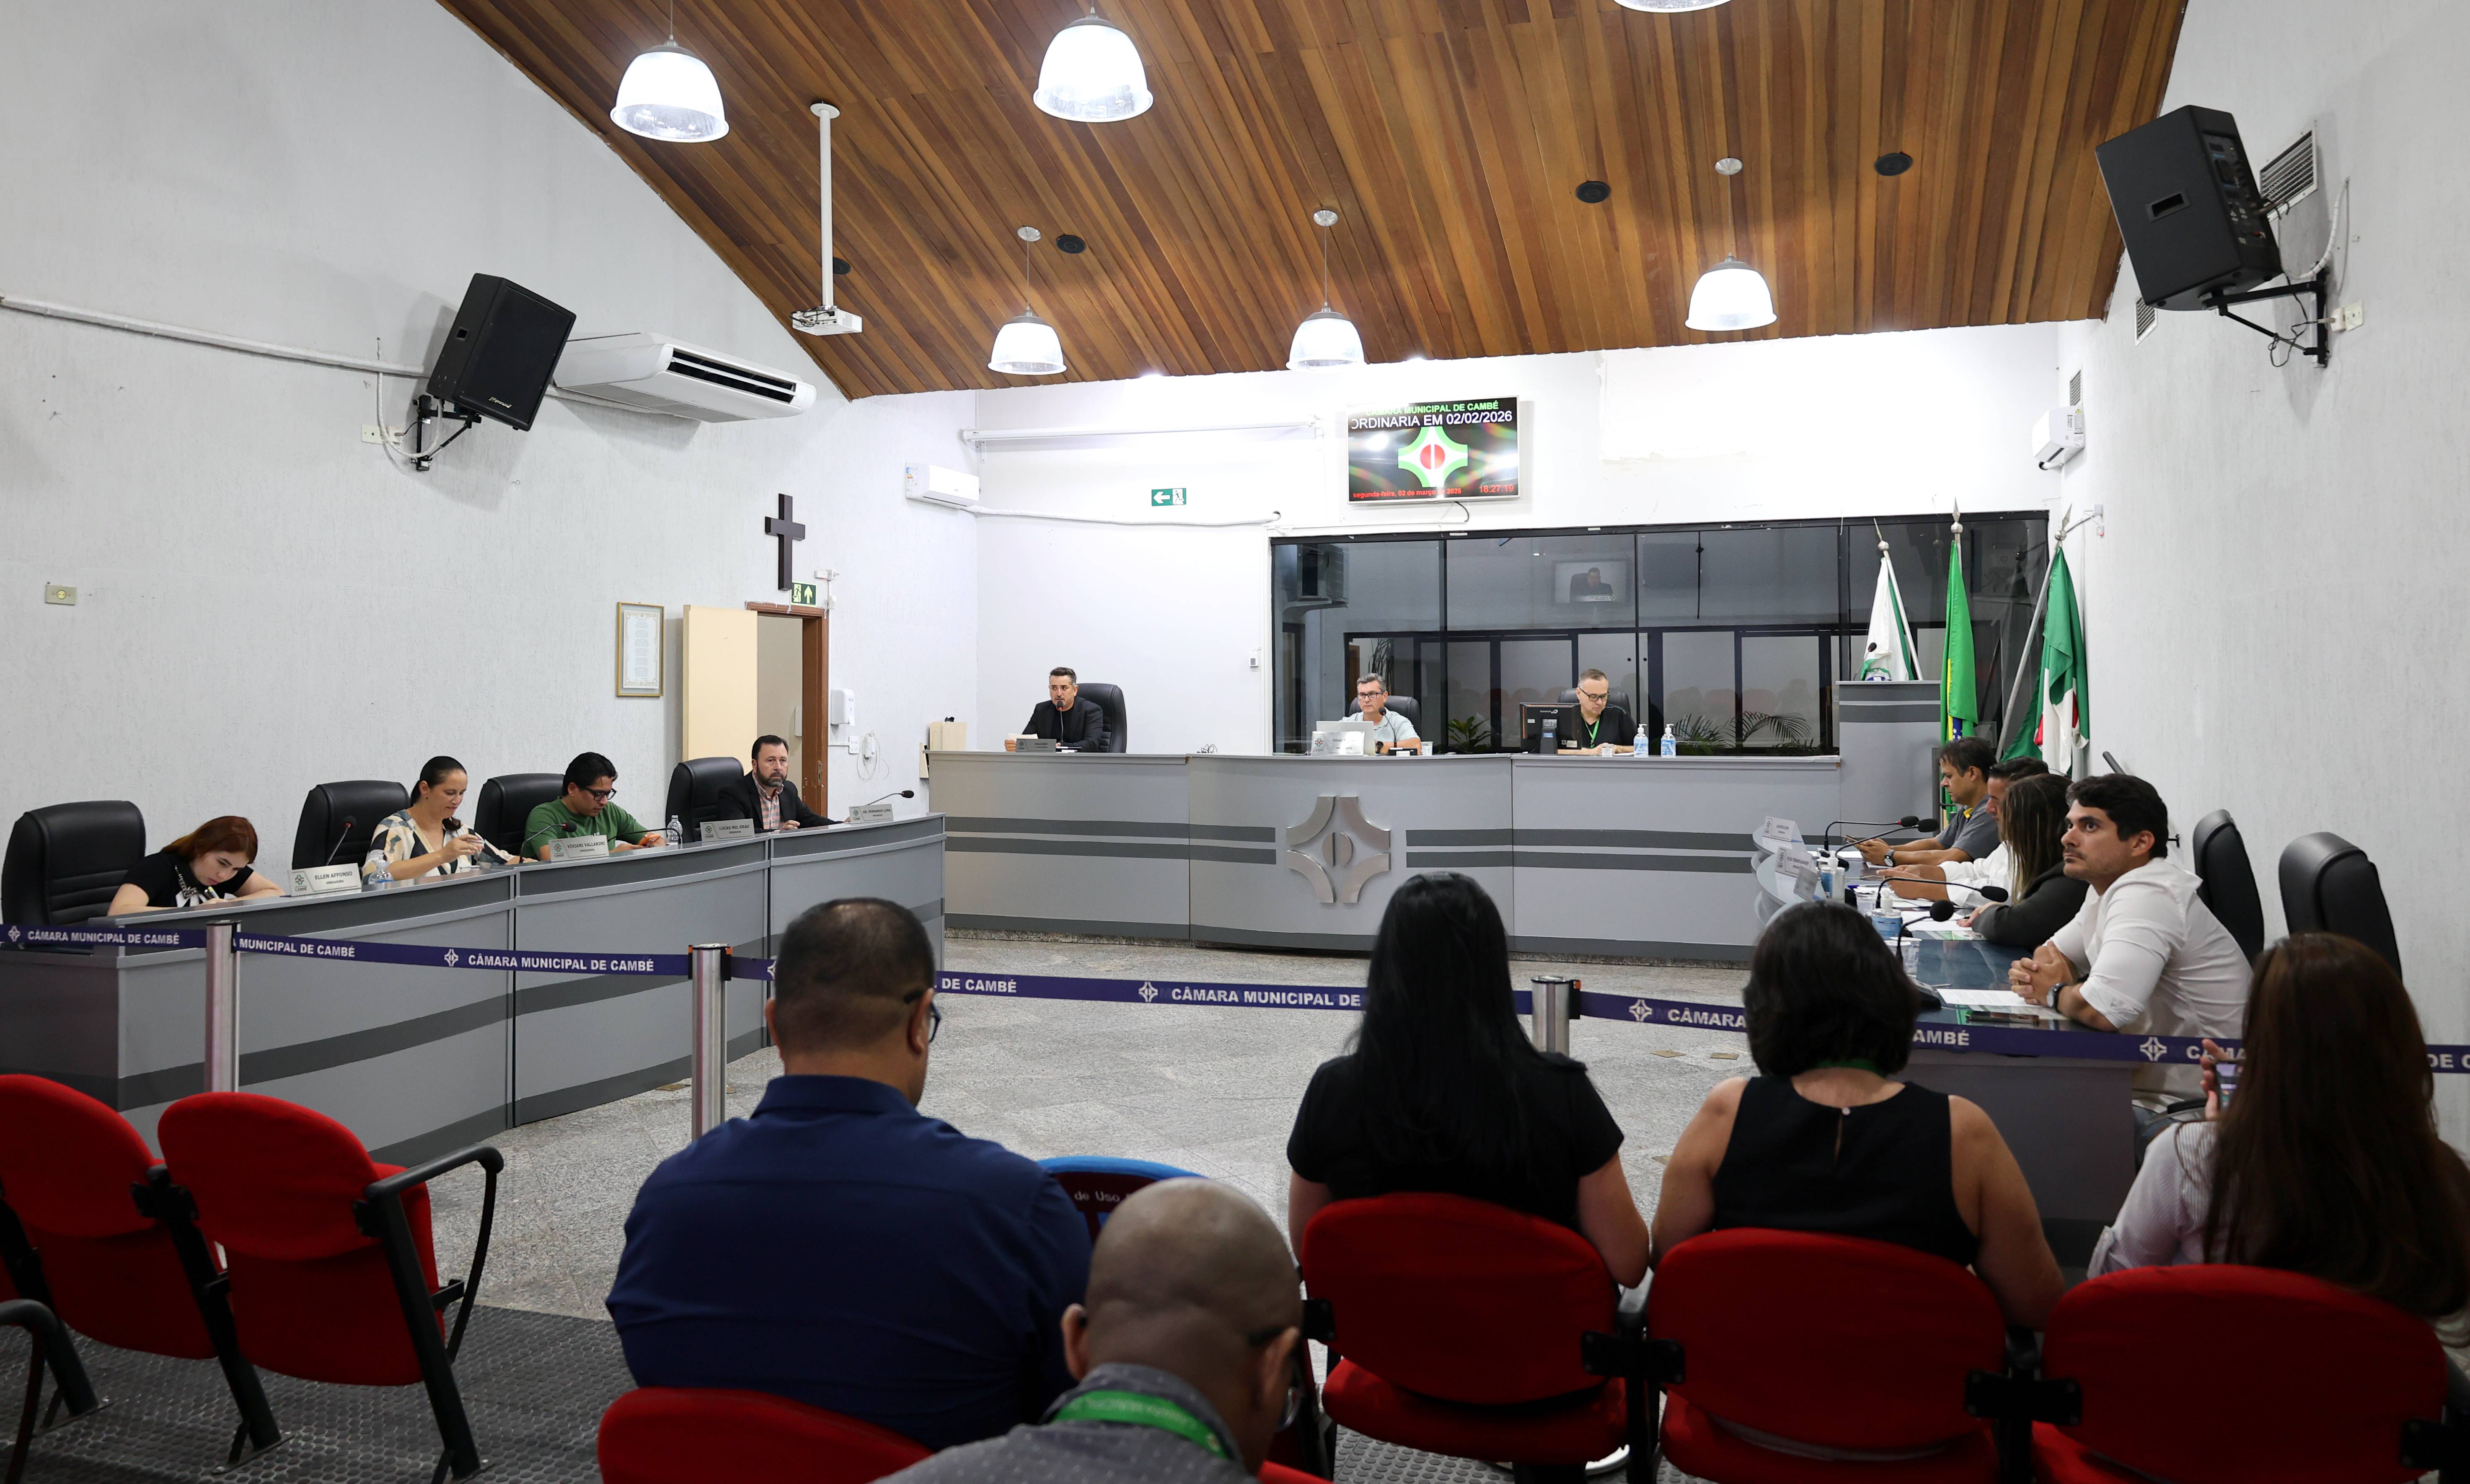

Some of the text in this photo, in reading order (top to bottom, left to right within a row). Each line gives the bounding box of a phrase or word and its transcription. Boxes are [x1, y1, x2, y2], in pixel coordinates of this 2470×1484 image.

[1404, 405, 1451, 414] MUNICIPAL
[1467, 400, 1499, 411] CAMBÉ
[1423, 414, 1443, 426] EM
[1446, 410, 1513, 425] 02/02/2026
[1478, 484, 1514, 493] 18:27:19
[28, 929, 180, 944] CÂMARA MUNICIPAL DE CAMBÉ
[239, 938, 297, 952] MUNICIPAL
[300, 944, 314, 954] DE
[317, 945, 355, 957] CAMBÉ
[468, 954, 654, 972] CÂMARA MUNICIPAL DE CAMBÉ
[941, 977, 1017, 993] DE CAMBÉ
[1172, 986, 1361, 1006] CÂMARA MUNICIPAL DE
[1668, 1007, 1747, 1028] CÂMARA
[1912, 1029, 1969, 1046] AMBÉ
[2427, 1054, 2454, 1068] DE
[1074, 1191, 1089, 1202] de
[1095, 1191, 1120, 1203] Uso
